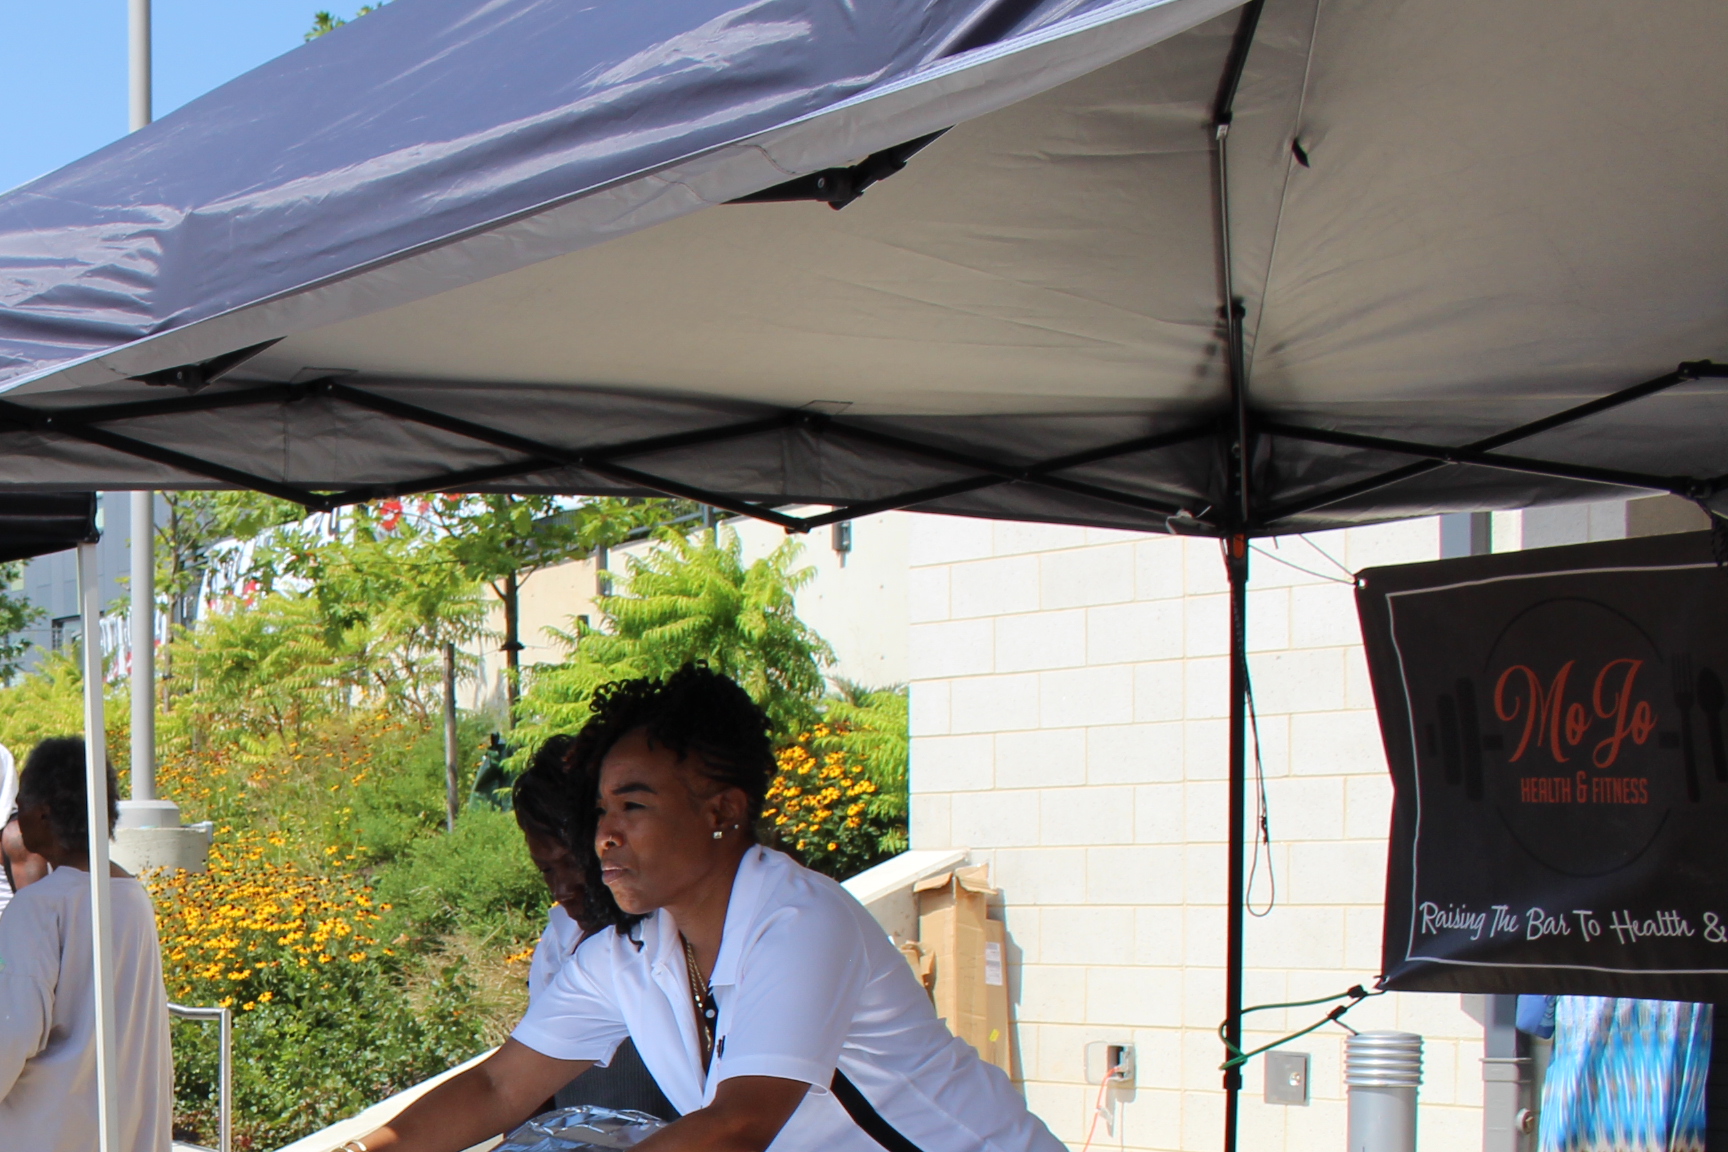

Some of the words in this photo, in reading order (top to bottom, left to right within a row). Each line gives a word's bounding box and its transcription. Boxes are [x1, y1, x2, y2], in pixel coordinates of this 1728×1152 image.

[1493, 658, 1658, 768] MoJo
[1520, 777, 1570, 803] HEALTH
[1576, 771, 1587, 803] &
[1592, 777, 1648, 804] FITNESS
[1419, 901, 1485, 941] Raising
[1489, 904, 1519, 938] The
[1526, 907, 1571, 940] Bar
[1573, 910, 1600, 942] To
[1610, 909, 1695, 945] Health
